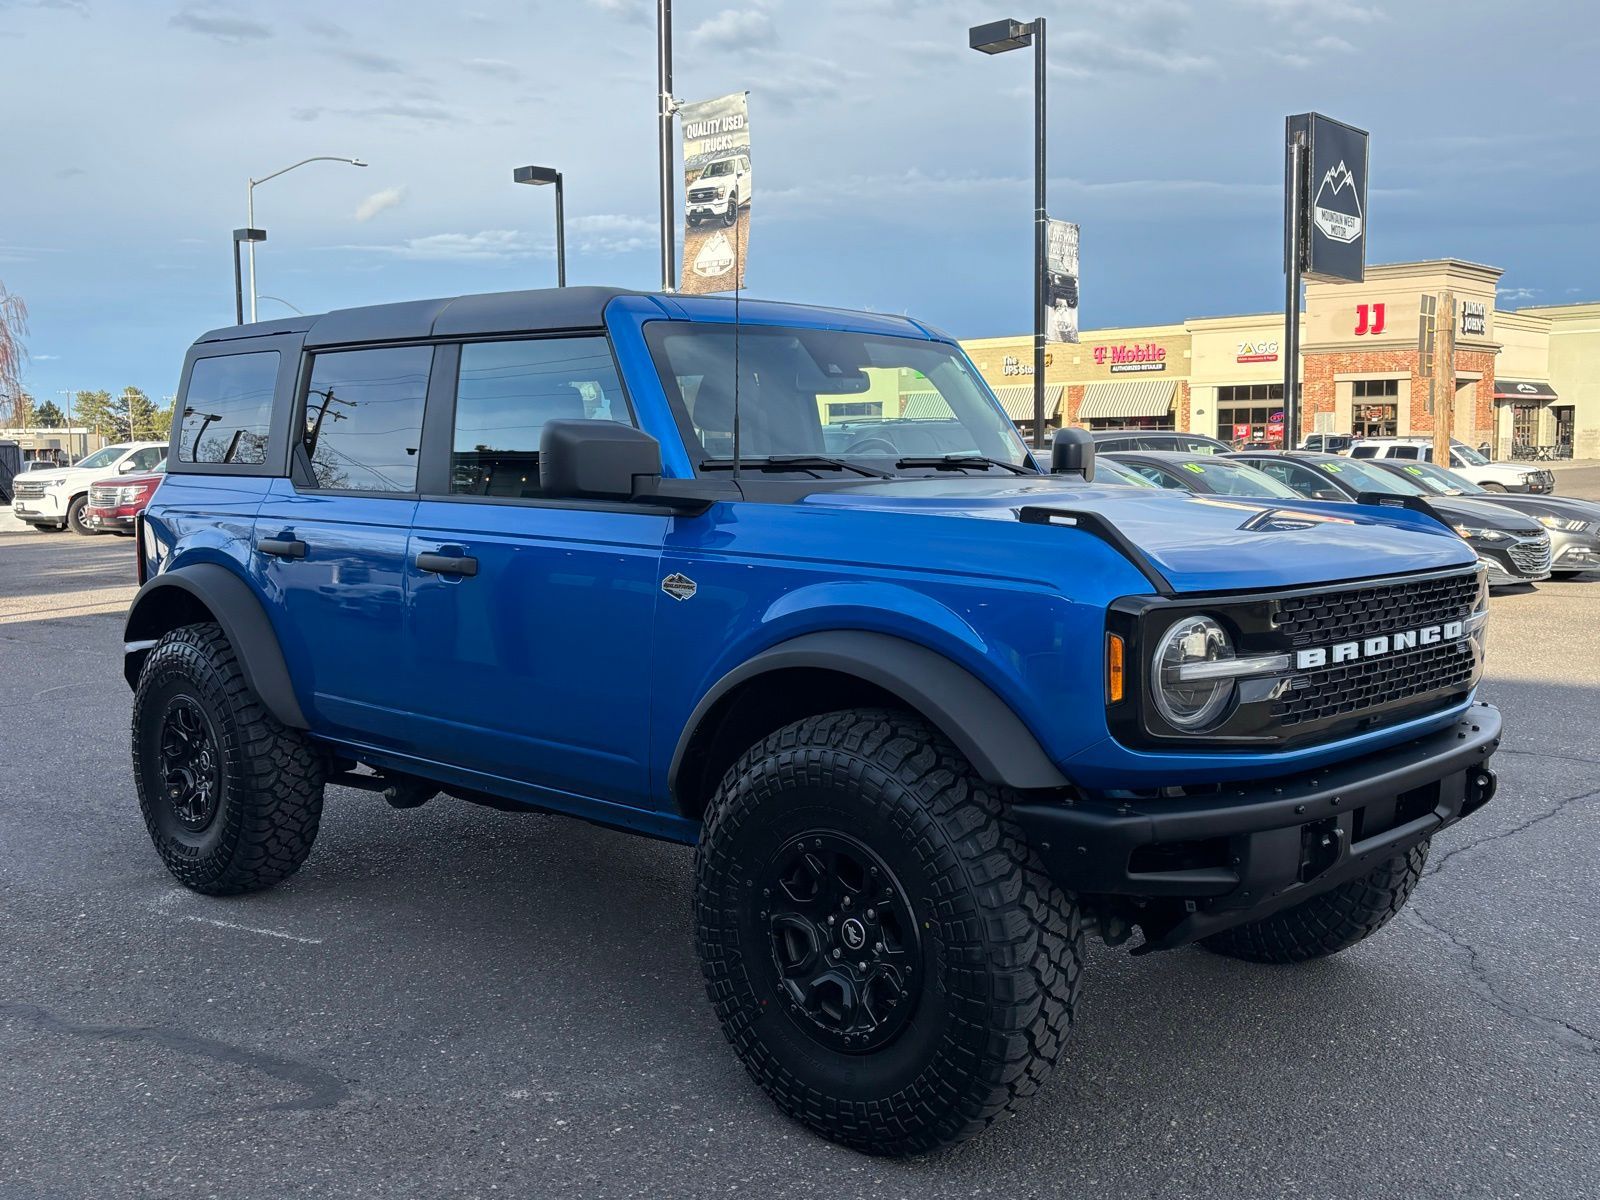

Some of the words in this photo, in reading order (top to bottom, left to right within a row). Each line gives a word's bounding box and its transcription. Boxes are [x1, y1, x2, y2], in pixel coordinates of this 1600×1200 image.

[687, 119, 721, 139] QUALITY
[722, 114, 744, 131] USED
[701, 135, 733, 154] TRUCKS
[1322, 209, 1344, 226] MOUNTAIN
[1343, 216, 1356, 228] WEST
[1330, 224, 1347, 237] MOTOR
[1464, 300, 1486, 316] JIMMY
[1464, 317, 1486, 333] JOHN'S
[1237, 341, 1279, 356] ZAGG
[1003, 356, 1019, 366] The
[1112, 364, 1141, 372] AUTHORIZED
[1141, 363, 1163, 371] RETAILER
[1003, 365, 1019, 377] UPS
[1019, 364, 1035, 376] Sto
[1296, 621, 1462, 669] BRONCO
